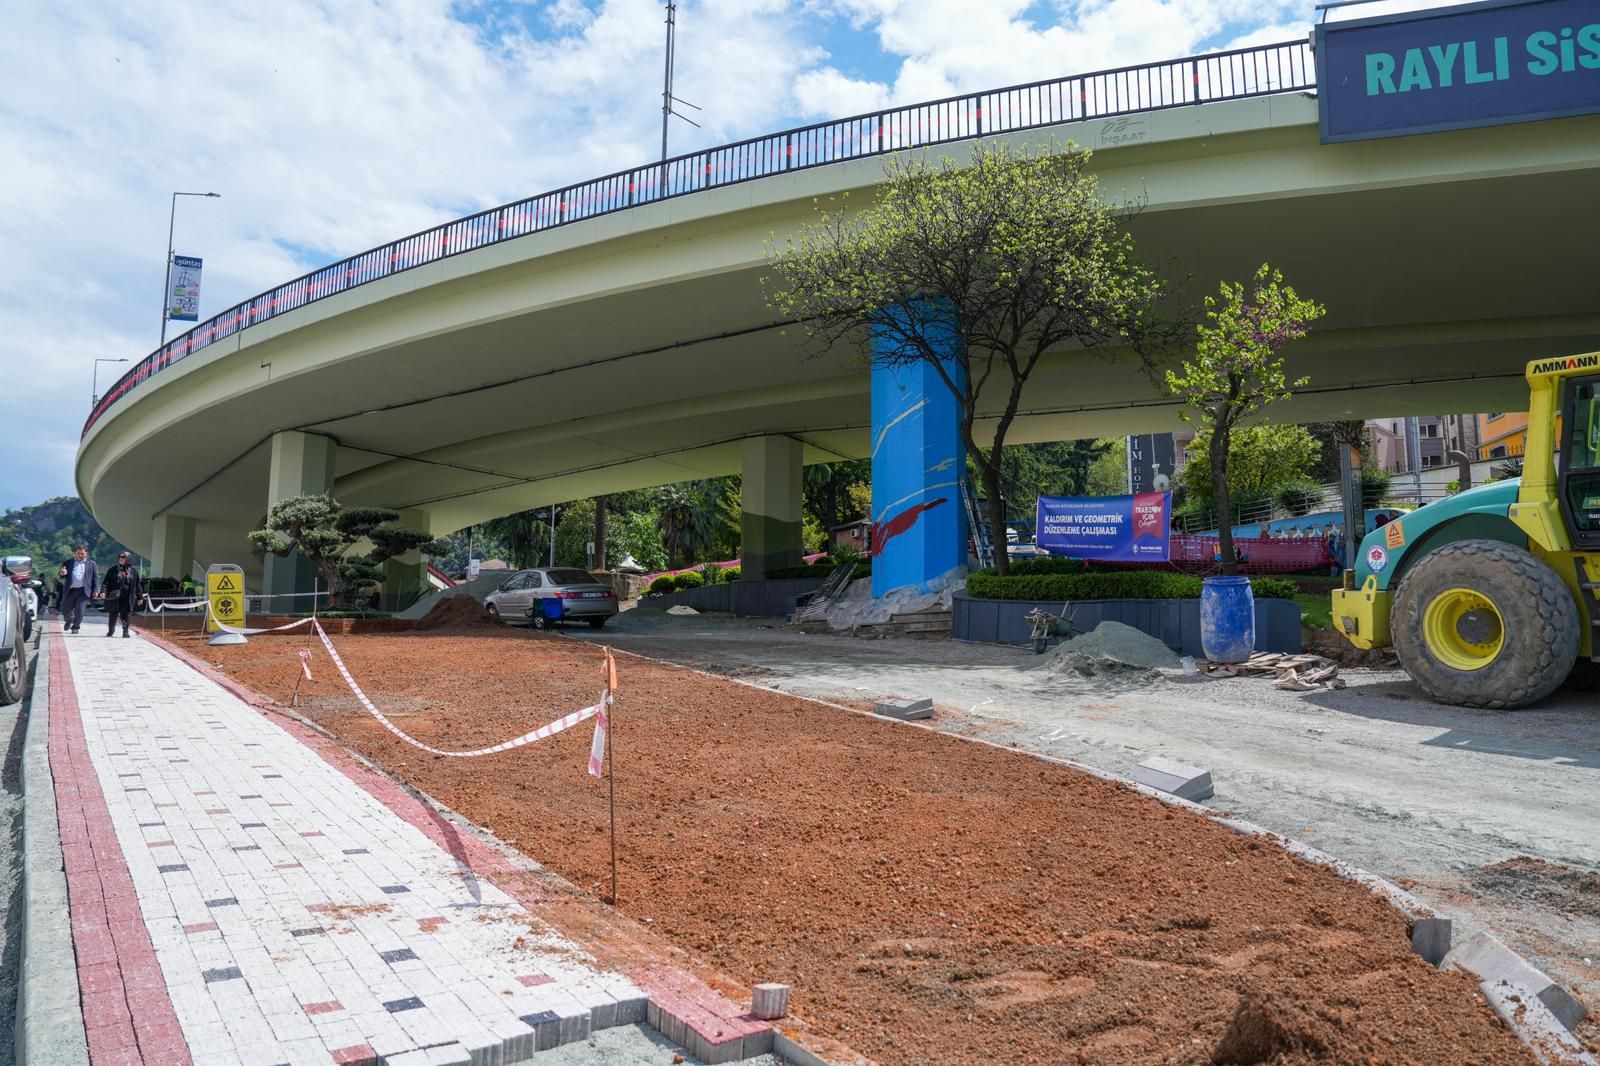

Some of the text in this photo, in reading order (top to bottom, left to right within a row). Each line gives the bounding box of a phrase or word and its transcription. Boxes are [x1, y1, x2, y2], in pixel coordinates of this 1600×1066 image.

[1365, 36, 1510, 96] RAYLI
[1533, 355, 1598, 374] AMMANN
[1135, 506, 1161, 514] TRABZON
[1044, 513, 1123, 524] KALDIRIM VE GEOMETRİK
[1044, 524, 1117, 537] DÜZENLEME ÇALIŞMASI
